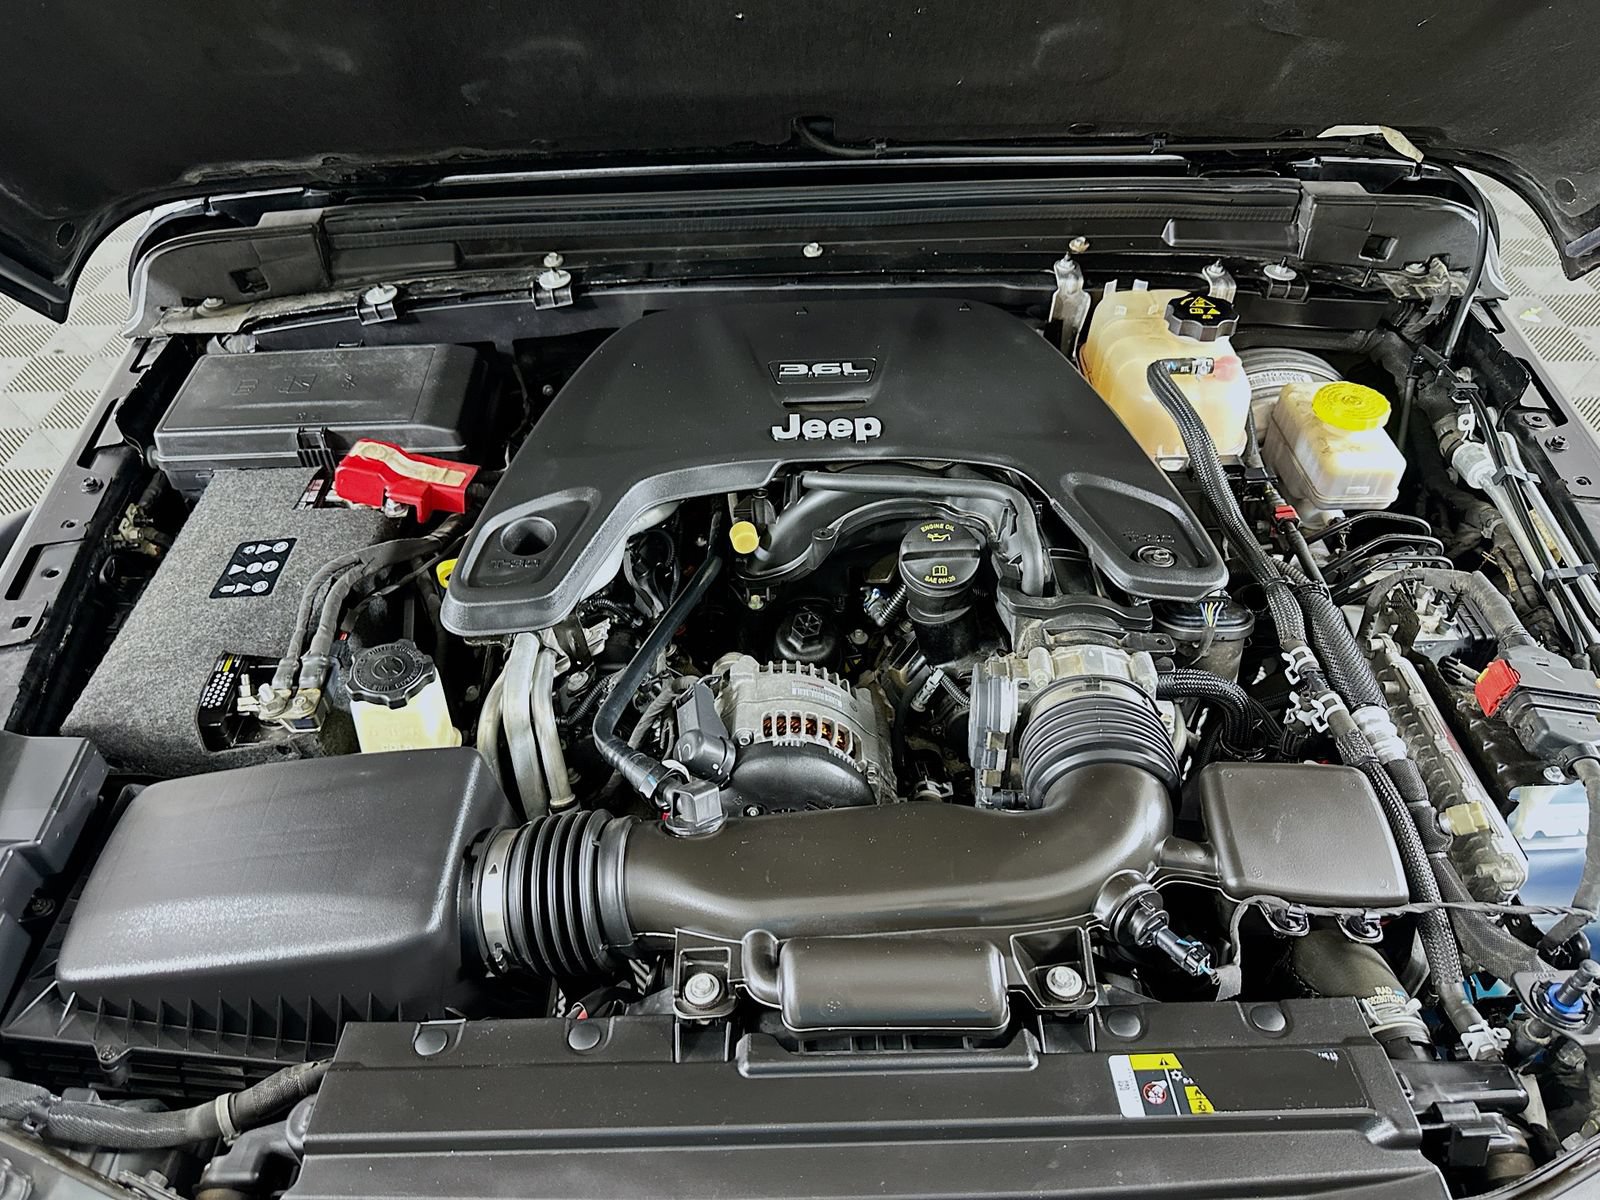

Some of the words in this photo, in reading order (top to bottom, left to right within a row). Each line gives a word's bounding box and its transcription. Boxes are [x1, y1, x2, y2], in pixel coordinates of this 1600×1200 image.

[780, 362, 869, 377] 3.6L
[771, 413, 882, 442] Jeep
[920, 523, 944, 533] ENGINE
[945, 524, 955, 532] OIL
[924, 575, 937, 584] SAE
[1374, 986, 1393, 995] RAD
